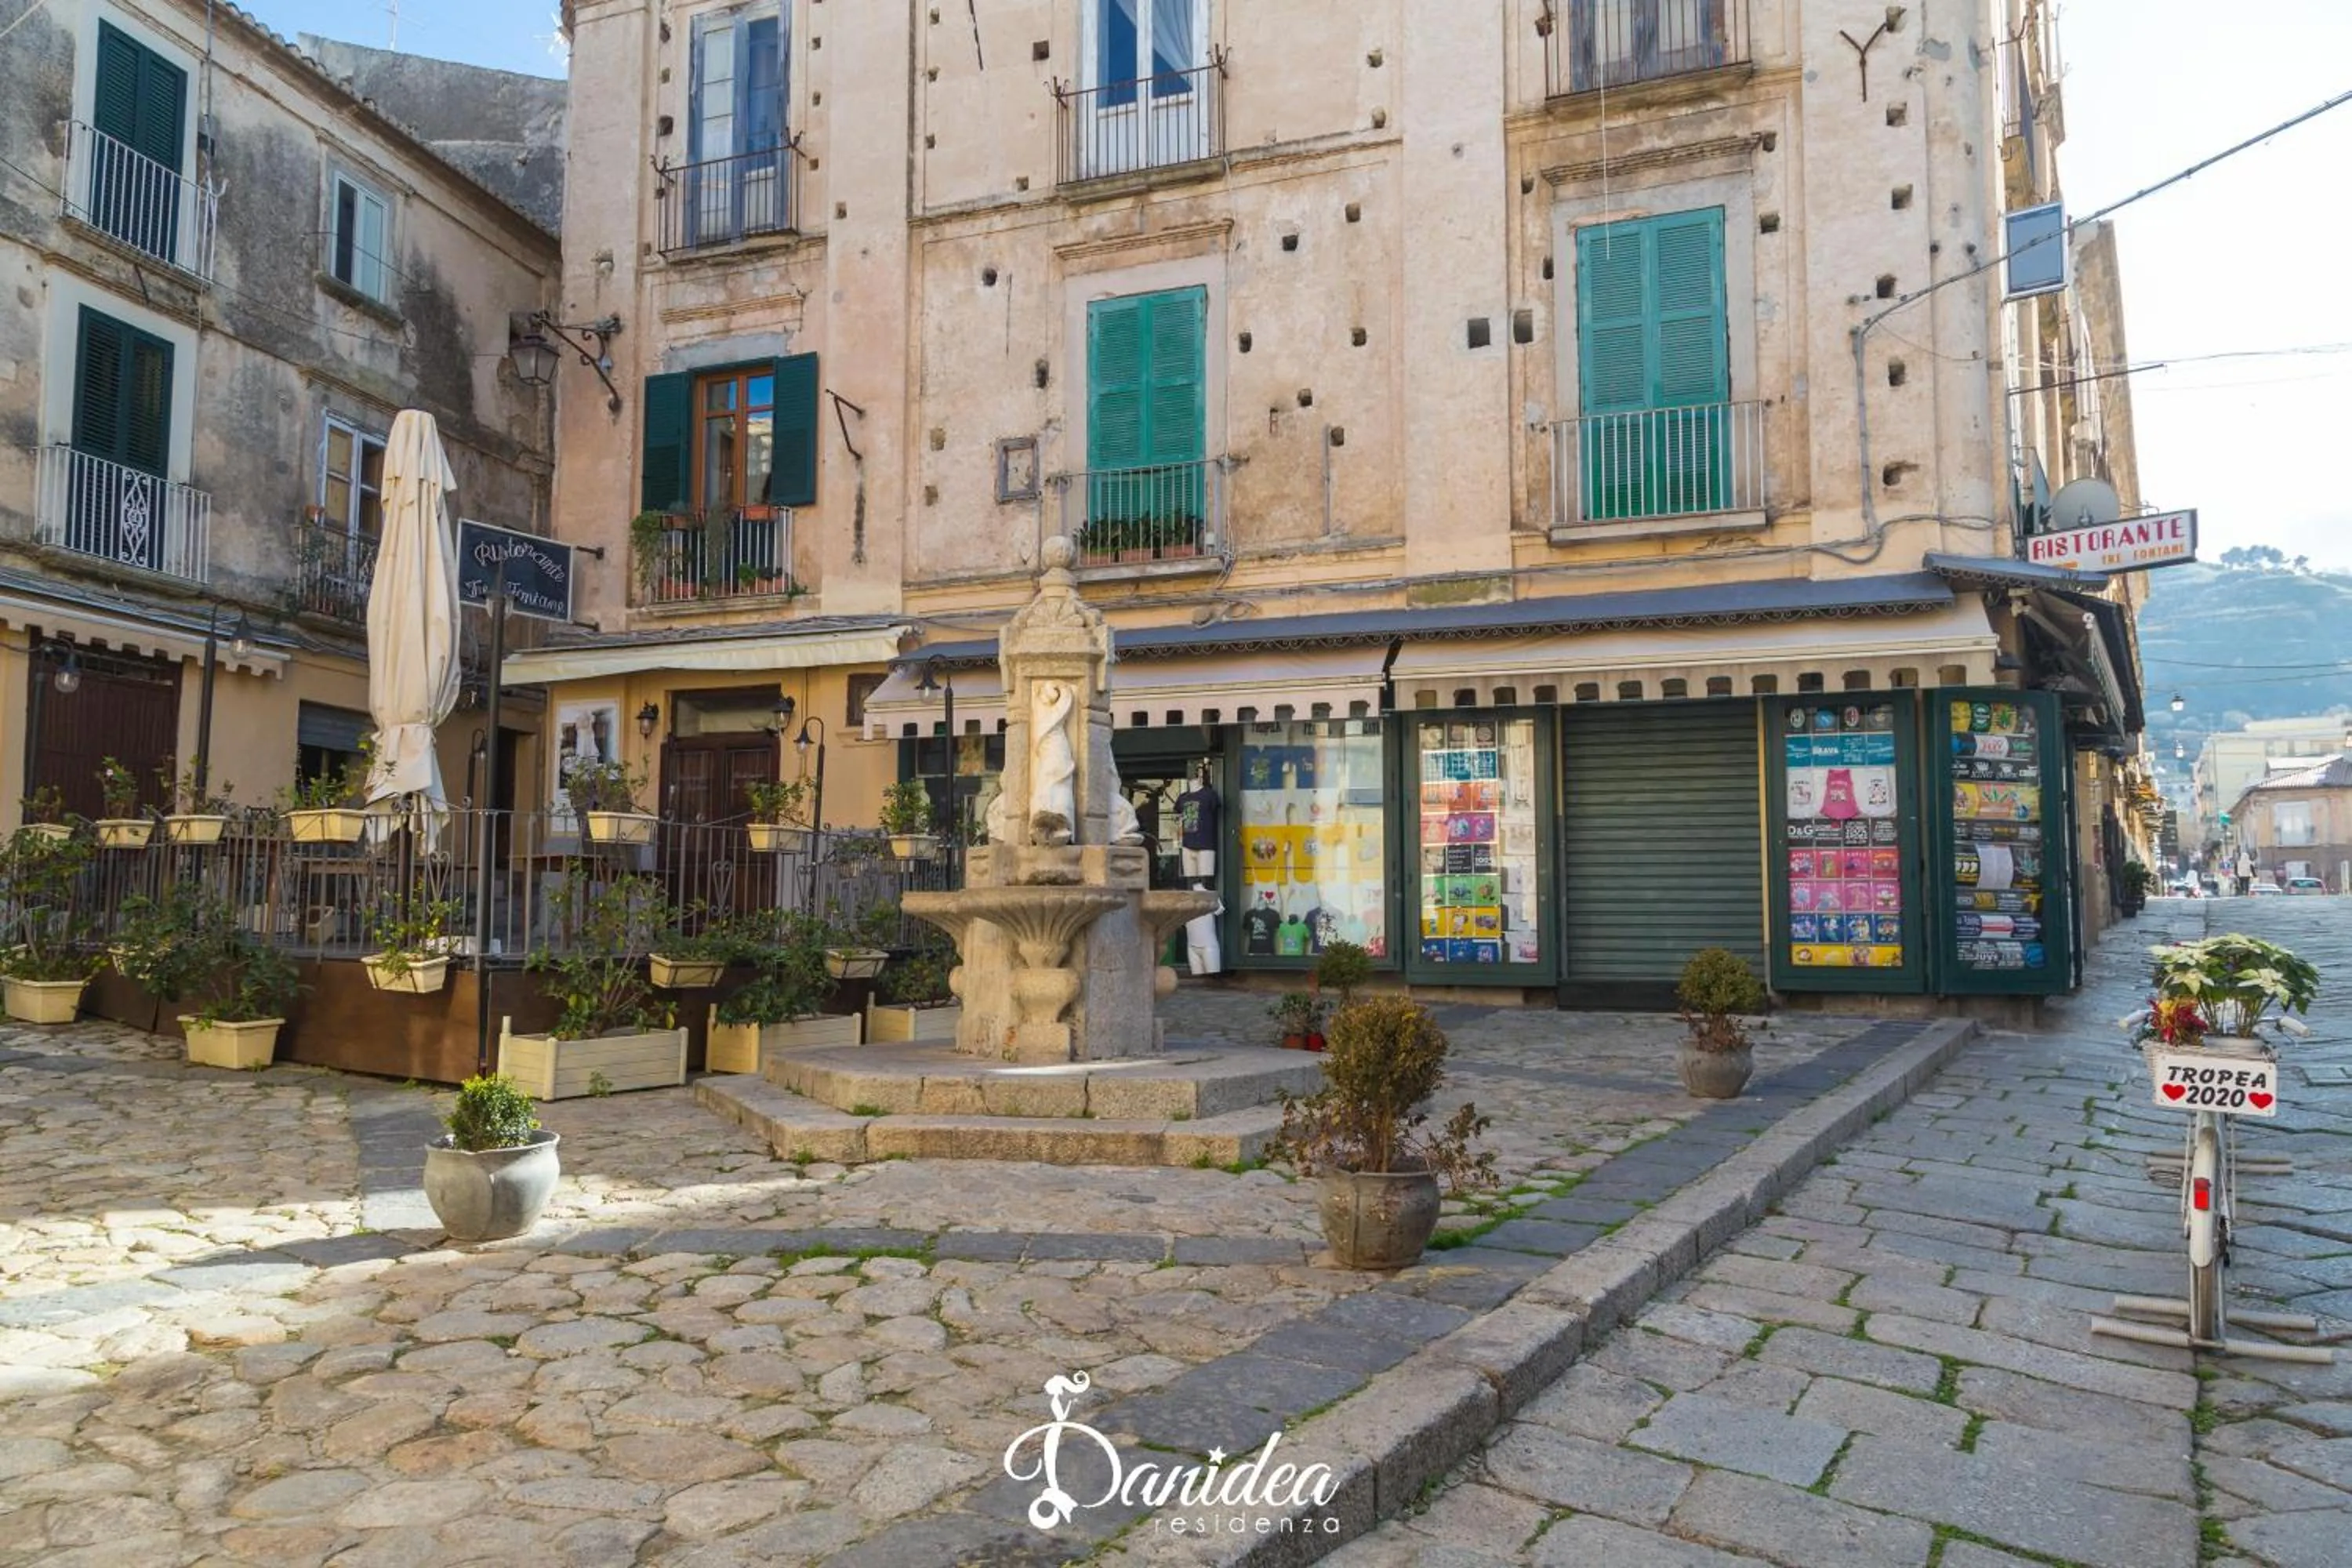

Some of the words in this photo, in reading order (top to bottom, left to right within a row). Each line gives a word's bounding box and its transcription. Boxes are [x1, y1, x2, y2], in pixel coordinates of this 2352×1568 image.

[2033, 517, 2185, 560] RISTORANTE
[474, 536, 565, 583] Ristorante
[1788, 825, 1813, 837] D&G
[2168, 1065, 2267, 1088] TROPEA
[2186, 1085, 2245, 1107] 2020
